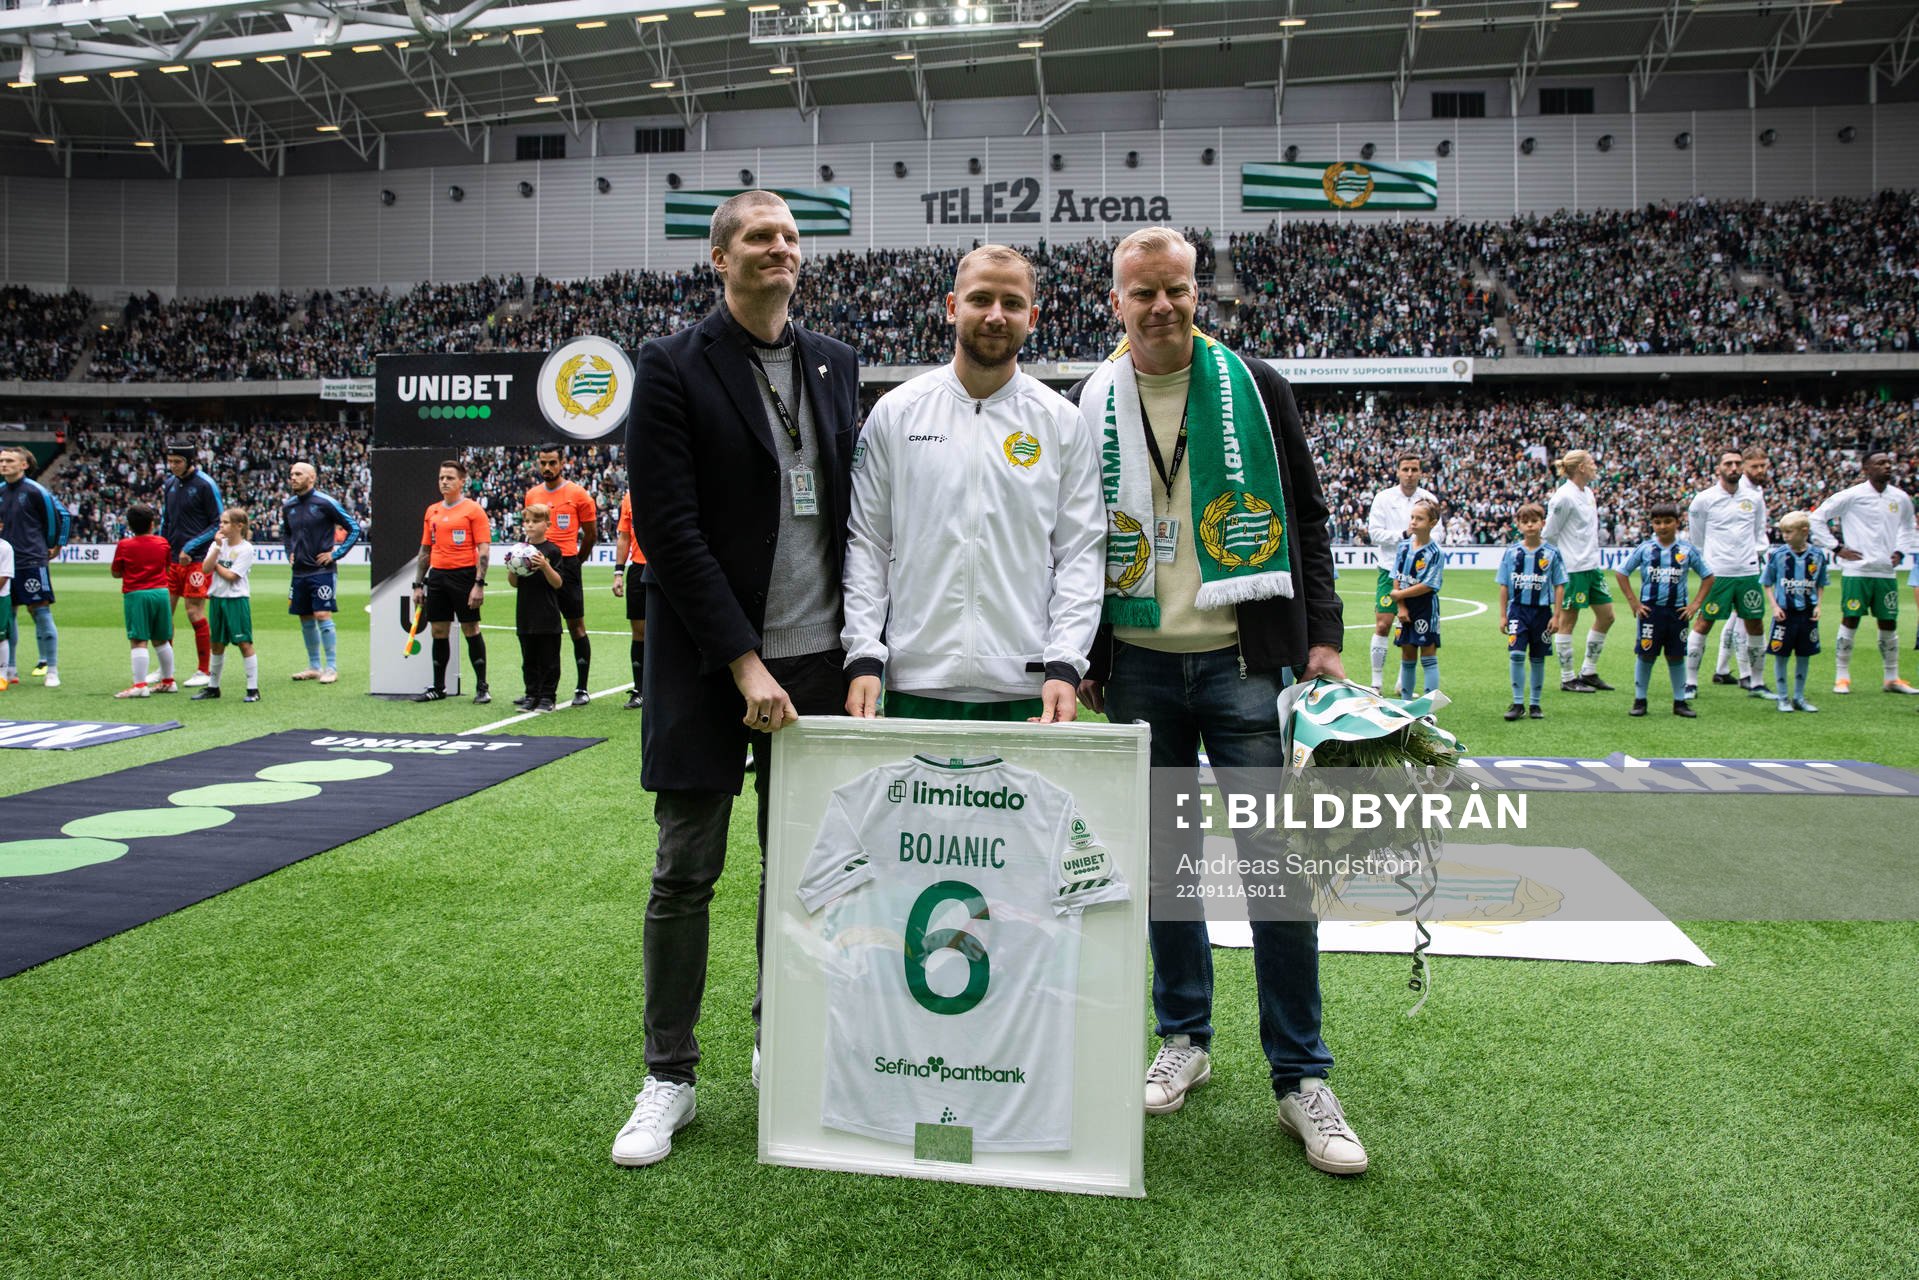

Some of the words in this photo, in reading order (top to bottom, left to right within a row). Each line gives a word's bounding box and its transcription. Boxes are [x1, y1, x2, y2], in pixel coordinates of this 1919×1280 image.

[920, 176, 1042, 225] TELE2
[1050, 188, 1172, 223] Arena
[1294, 367, 1307, 376] EN
[1311, 367, 1350, 376] POSITIV
[1353, 366, 1449, 376] SUPPORTERKULTUR
[397, 374, 513, 402] UNIBET
[908, 434, 939, 443] CRAFT
[311, 736, 523, 751] UNIBET
[913, 780, 1025, 810] limitado
[900, 832, 1006, 869] BOJANIC
[1063, 853, 1105, 871] UNIBET
[904, 880, 991, 1015] 6
[874, 1056, 931, 1078] Sefina
[940, 1065, 1026, 1084] pantbank
